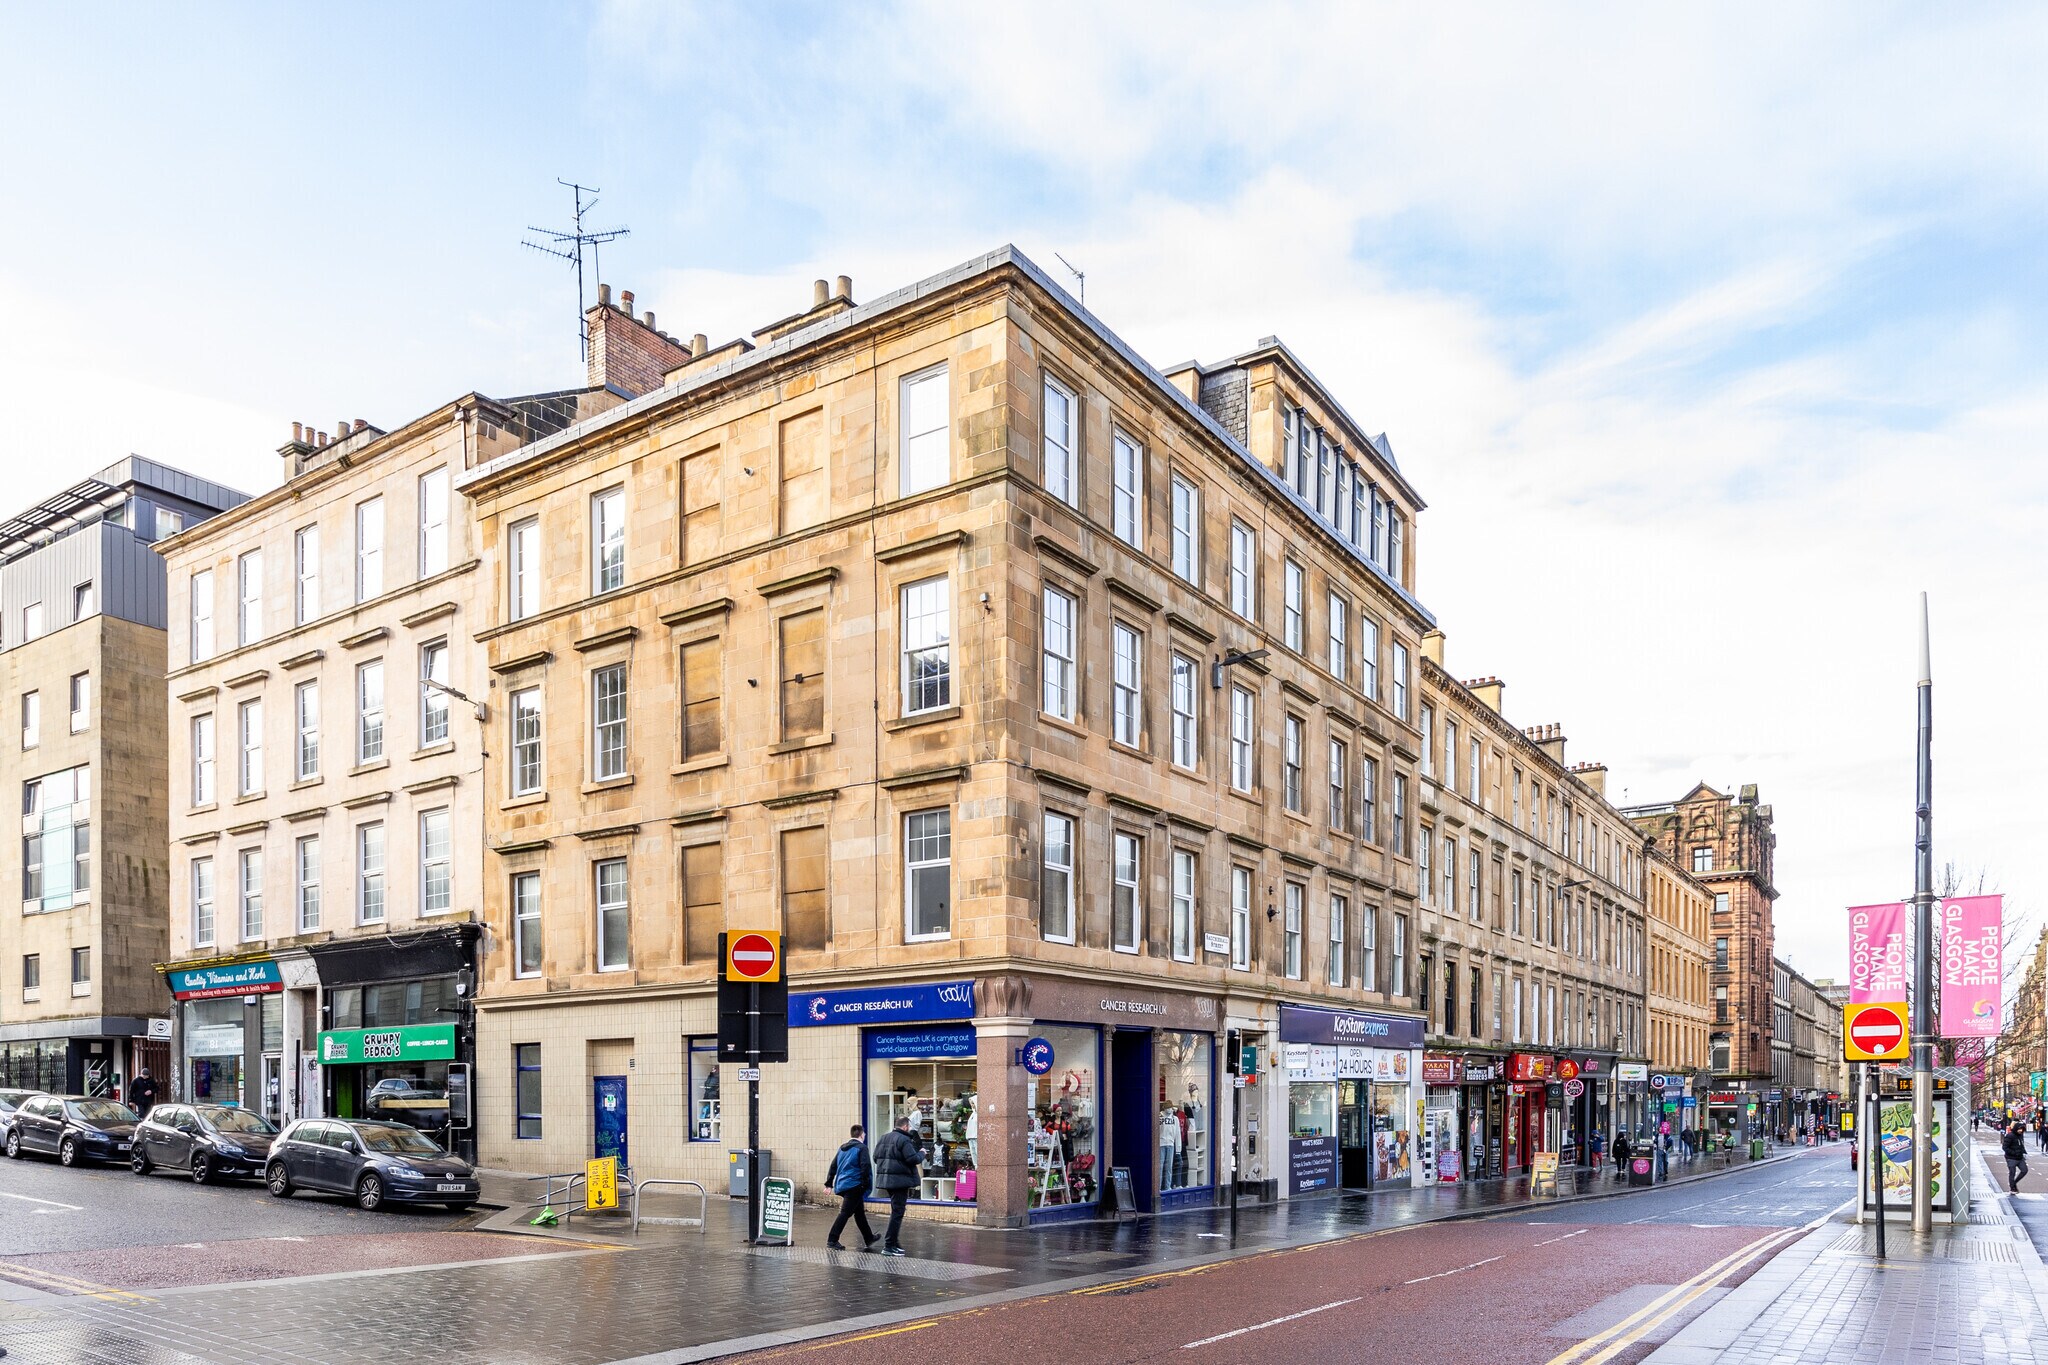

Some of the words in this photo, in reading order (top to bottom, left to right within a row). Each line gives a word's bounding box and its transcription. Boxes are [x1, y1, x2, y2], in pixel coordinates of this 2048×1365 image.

[1853, 912, 1869, 991] GLASGOW
[1946, 904, 1962, 986] GLASGOW
[1887, 932, 1902, 990] PEOPLE
[1963, 940, 1980, 986] MAKE
[1981, 926, 1998, 985] PEOPLE
[1869, 946, 1885, 992] MAKE
[184, 973, 206, 989] Quality
[206, 970, 234, 984] Vitamins
[235, 969, 248, 981] and
[247, 966, 266, 980] Herbs
[834, 1001, 862, 1012] CANCER
[864, 1000, 901, 1011] RESEARCH
[903, 1000, 913, 1008] UK
[1100, 1000, 1127, 1012] CANCER
[1128, 1002, 1158, 1014] RESEARCH
[1159, 1005, 1167, 1015] UK
[364, 1033, 400, 1045] GRUMPY
[876, 1036, 895, 1044] Cancer
[896, 1035, 920, 1043] Research
[936, 1034, 959, 1043] carrying
[364, 1045, 400, 1056] PEDRO'S
[876, 1045, 908, 1053] world-class
[909, 1044, 933, 1052] research
[942, 1043, 968, 1053] Glasgow
[1350, 1048, 1362, 1057] OPEN
[1339, 1059, 1347, 1074] 24
[1350, 1060, 1372, 1074] HOURS
[592, 1165, 600, 1186] traffic
[602, 1161, 610, 1188] Diverted
[766, 1200, 790, 1210] VEGAN
[766, 1208, 789, 1217] ORGANIC
